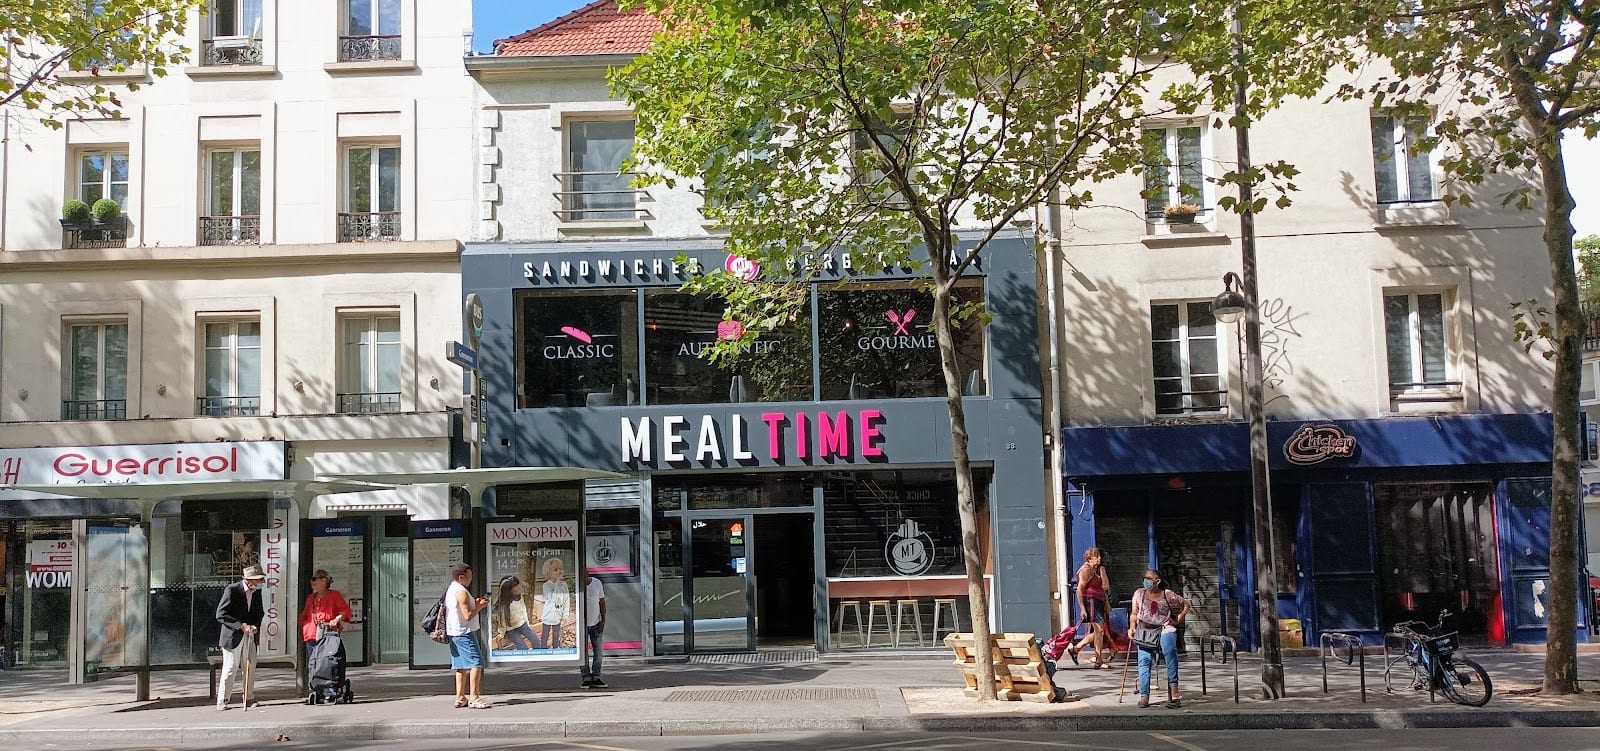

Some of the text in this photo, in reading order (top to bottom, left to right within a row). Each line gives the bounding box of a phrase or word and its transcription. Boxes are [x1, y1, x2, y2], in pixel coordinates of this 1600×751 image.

[523, 257, 698, 278] SANDWICHES
[857, 335, 936, 350] GOURME
[543, 344, 614, 360] CLASSIC
[1297, 430, 1354, 451] Chicken
[1319, 446, 1350, 454] spot
[53, 447, 237, 477] Guerrisol
[692, 521, 708, 529] حلال
[492, 526, 573, 540] MONOPRIX
[495, 548, 506, 558] La
[507, 548, 530, 557] classe
[901, 543, 915, 559] MT
